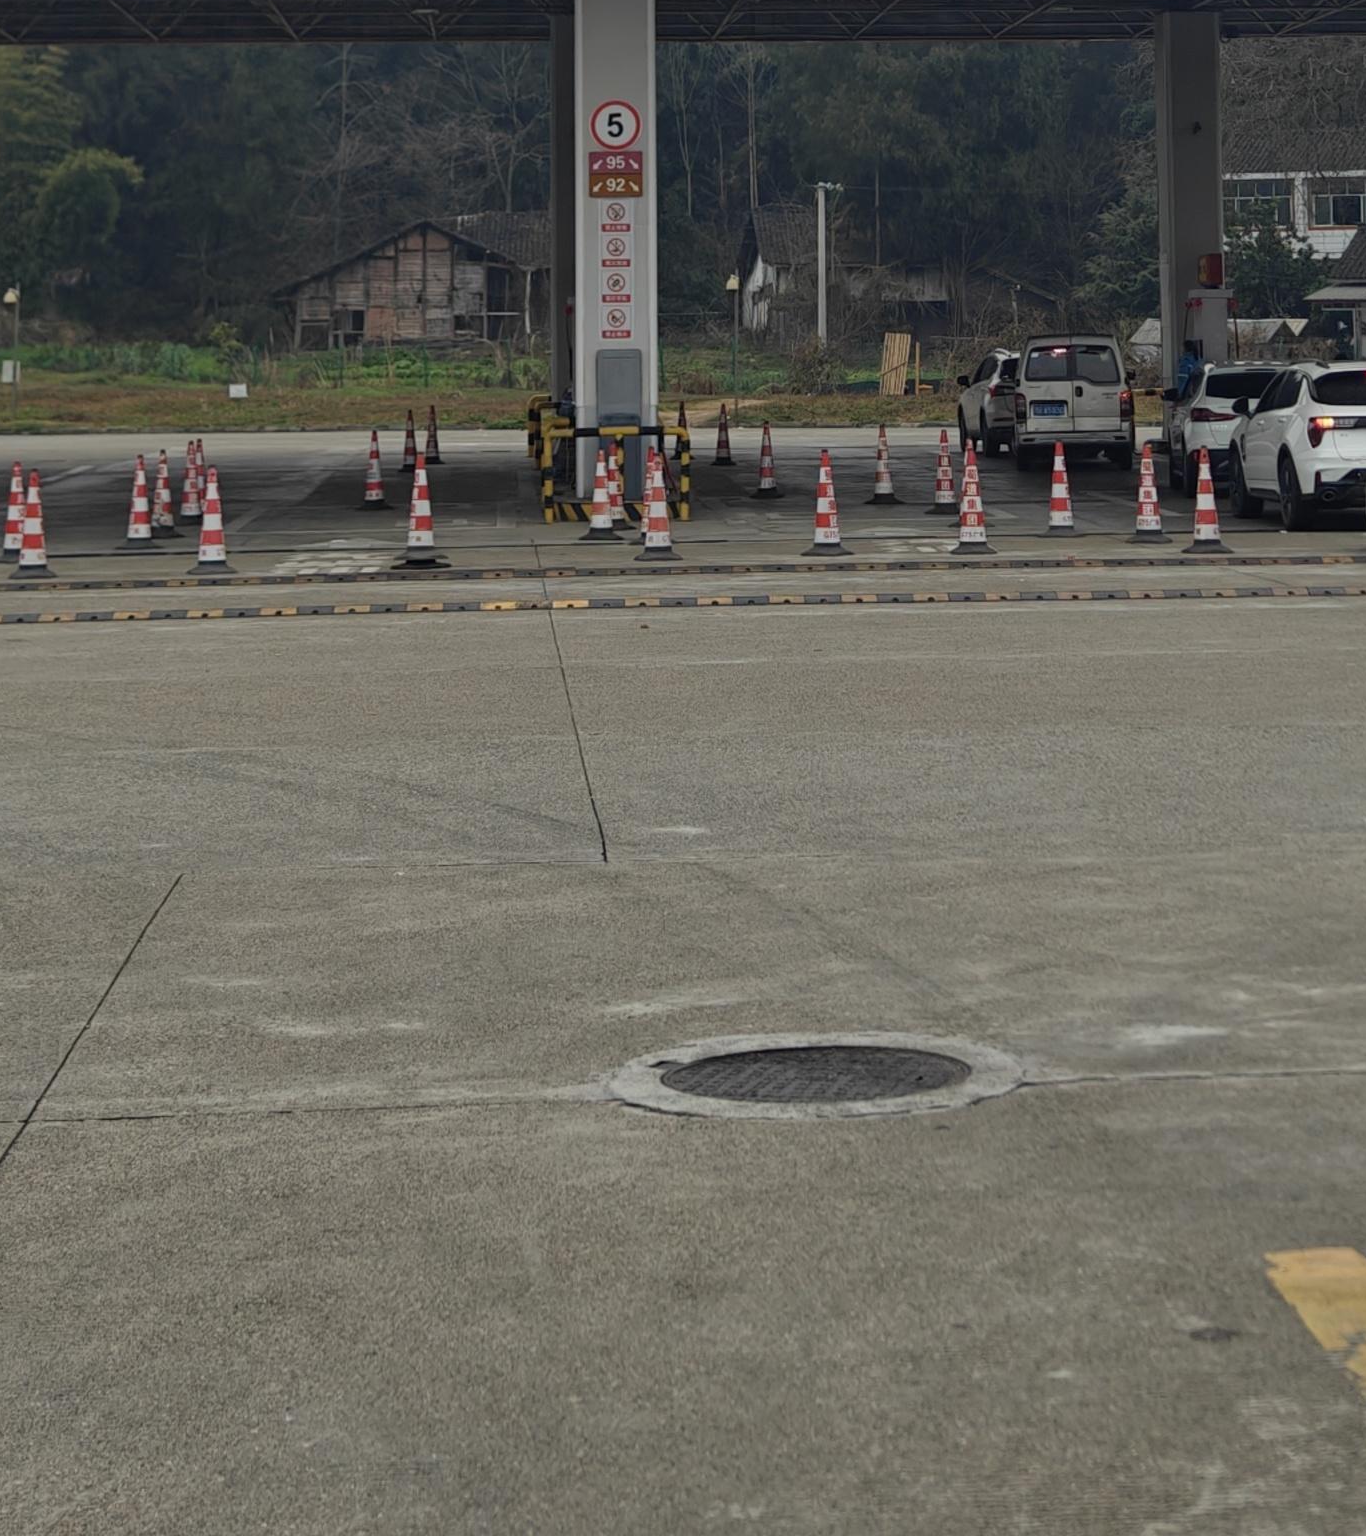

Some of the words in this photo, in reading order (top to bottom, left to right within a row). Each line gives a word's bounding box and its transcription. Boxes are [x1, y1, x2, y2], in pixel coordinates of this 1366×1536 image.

[606, 112, 625, 138] 5
[606, 155, 626, 170] 95
[606, 178, 626, 193] 92
